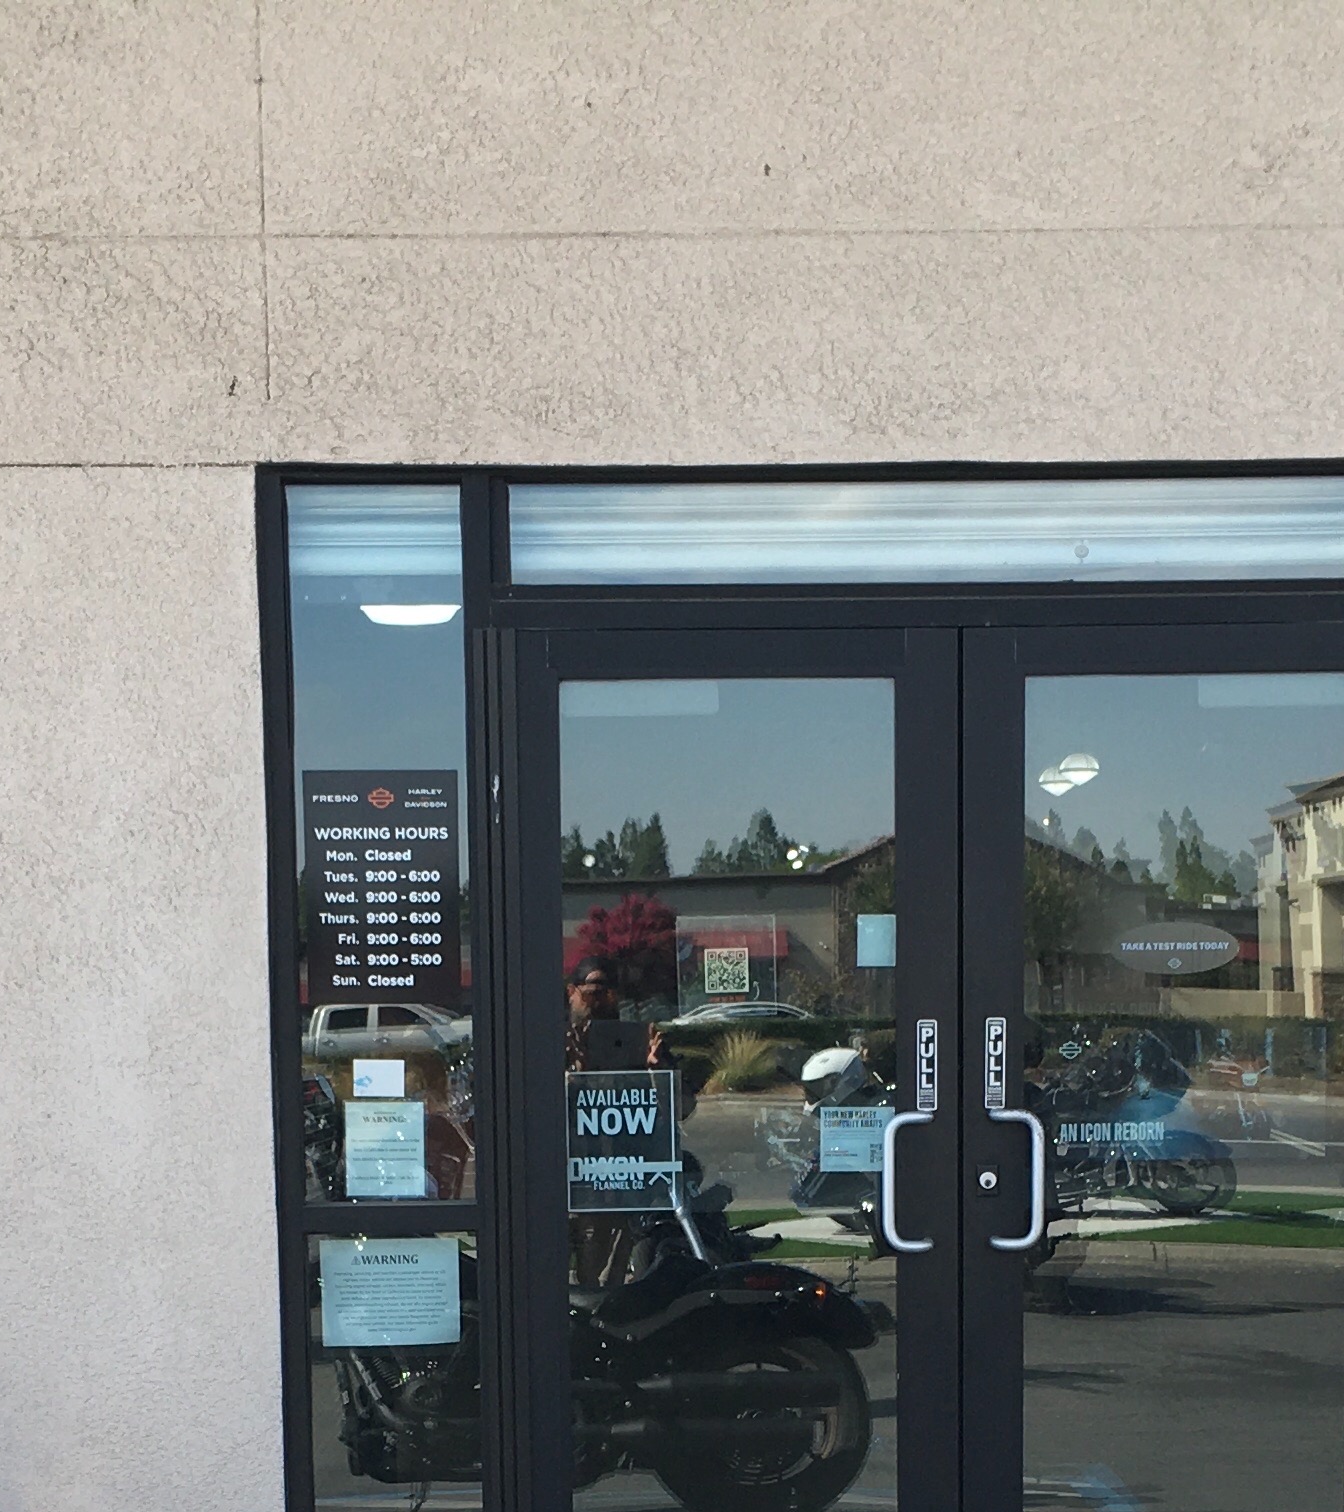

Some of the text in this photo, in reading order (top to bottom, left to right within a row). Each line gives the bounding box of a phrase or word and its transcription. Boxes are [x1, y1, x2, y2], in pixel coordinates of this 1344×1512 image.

[312, 794, 359, 803] FRESNO
[404, 801, 448, 809] DAVIDSON
[314, 827, 449, 841] WORKING HOURS
[326, 849, 412, 862] Mon. Closed
[324, 871, 358, 883] Tues.
[365, 871, 397, 883] 9:00
[408, 870, 441, 882] 6:00
[324, 892, 359, 903] Wed.
[365, 892, 397, 903] 9:00
[409, 891, 441, 903] 6:00
[319, 913, 359, 924] Thurs.
[366, 913, 398, 924] 9:00
[409, 912, 441, 924] 6:00
[338, 934, 360, 946] Fri.
[367, 933, 399, 945] 9:00
[410, 933, 442, 945] 6:00
[1121, 941, 1230, 951] TAKE A TEST RIDE TODAY
[335, 955, 360, 966] Sat.
[367, 954, 399, 966] 9:00
[410, 954, 442, 966] 5:00
[333, 974, 415, 987] Sun. Closed
[920, 1027, 934, 1088] PULL
[989, 1025, 1003, 1086] PULL
[576, 1088, 658, 1107] AVAILABLE
[577, 1107, 657, 1136] NOW
[1060, 1121, 1165, 1142] AN ICON REBORN
[593, 1181, 630, 1190] FLANNEL
[361, 1254, 419, 1265] WARNING
